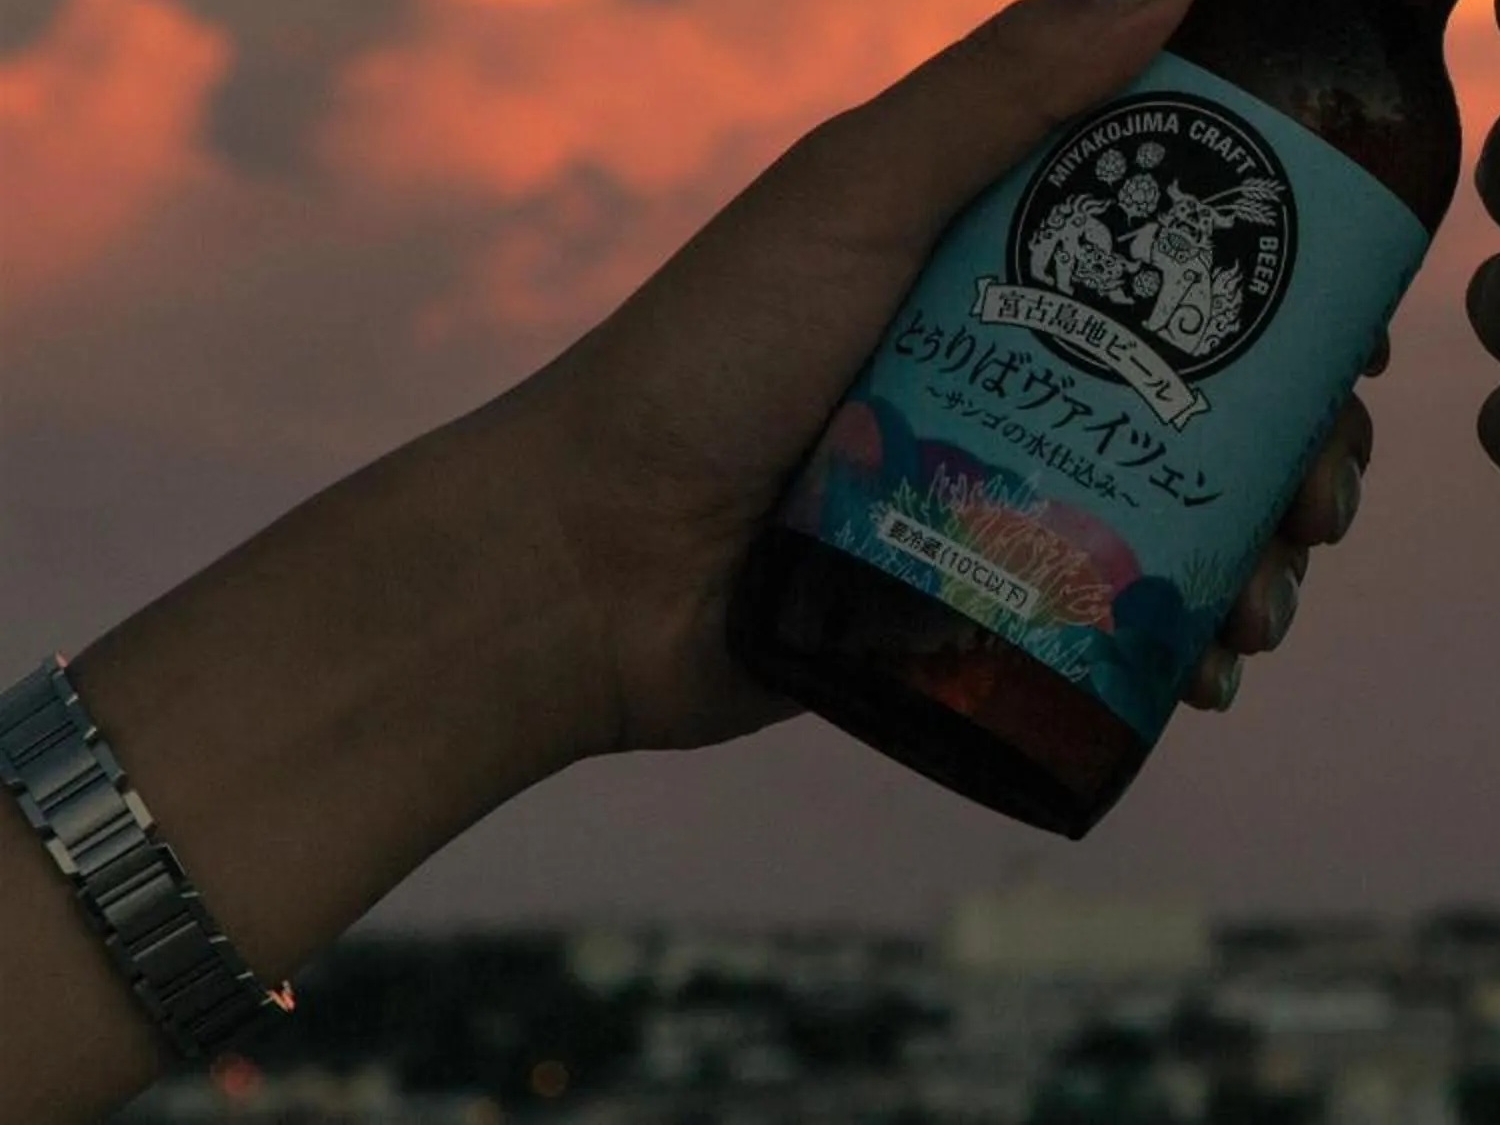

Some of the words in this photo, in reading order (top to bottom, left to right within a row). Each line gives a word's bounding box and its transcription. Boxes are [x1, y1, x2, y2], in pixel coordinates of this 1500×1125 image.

[1048, 111, 1180, 189] MIYAKOJIMA
[1188, 118, 1257, 175] CRAFT
[1248, 235, 1280, 297] BEER
[996, 290, 1175, 403] 宮古島地ビール
